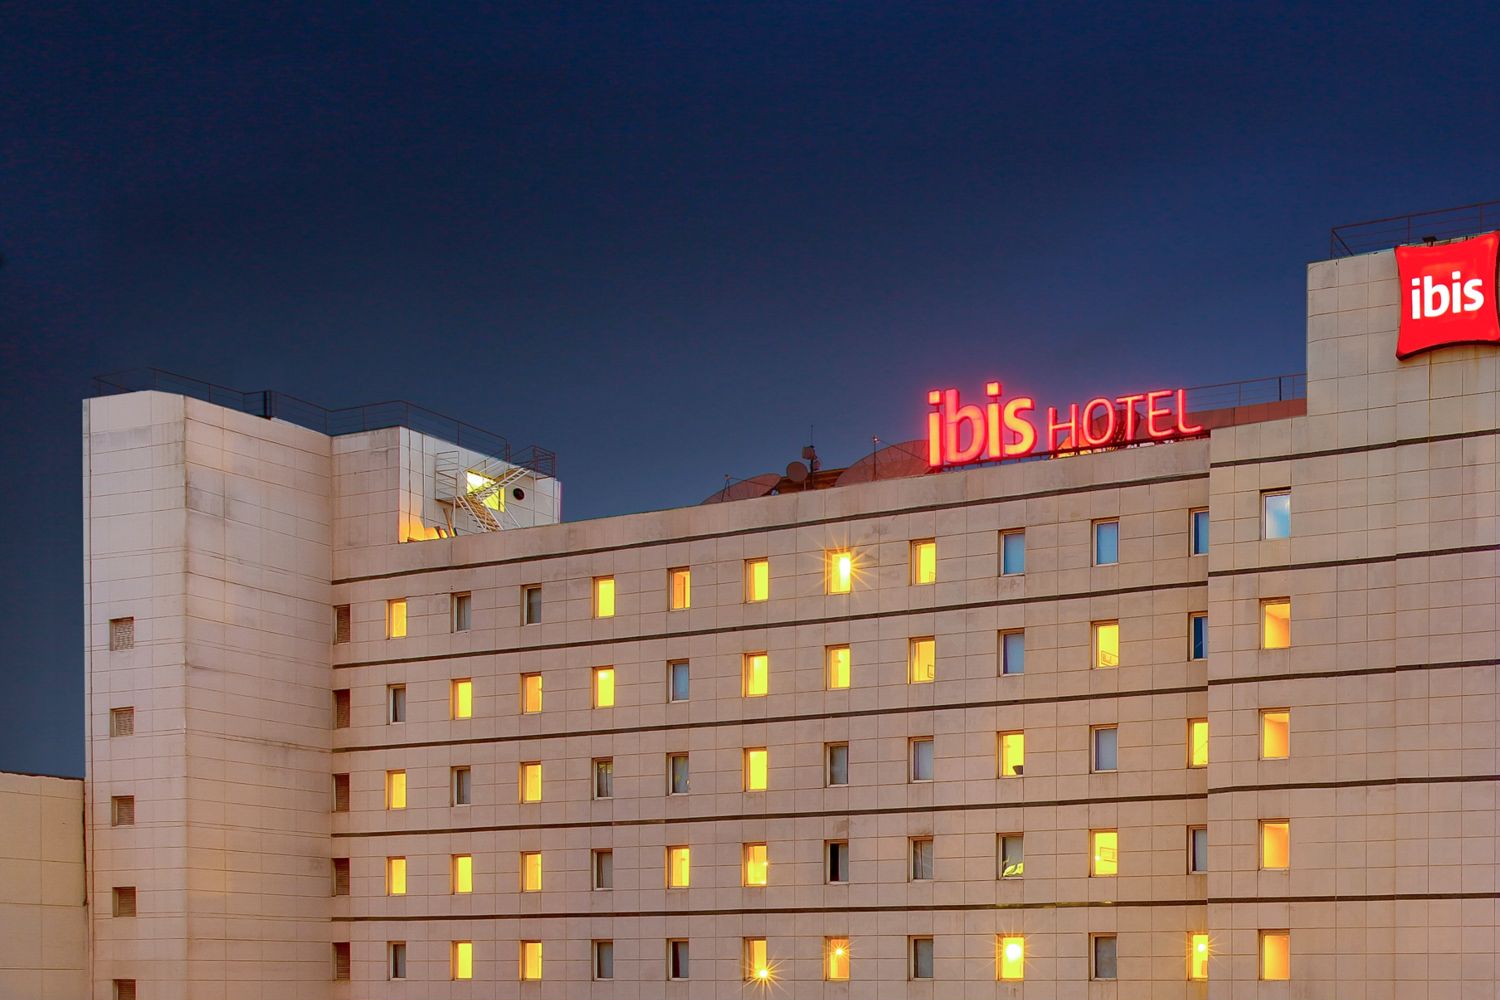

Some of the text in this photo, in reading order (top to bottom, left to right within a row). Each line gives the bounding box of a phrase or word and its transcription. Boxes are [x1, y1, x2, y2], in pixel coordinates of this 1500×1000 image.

[1411, 271, 1484, 320] ibis
[928, 381, 1203, 468] ibis HOTEL
